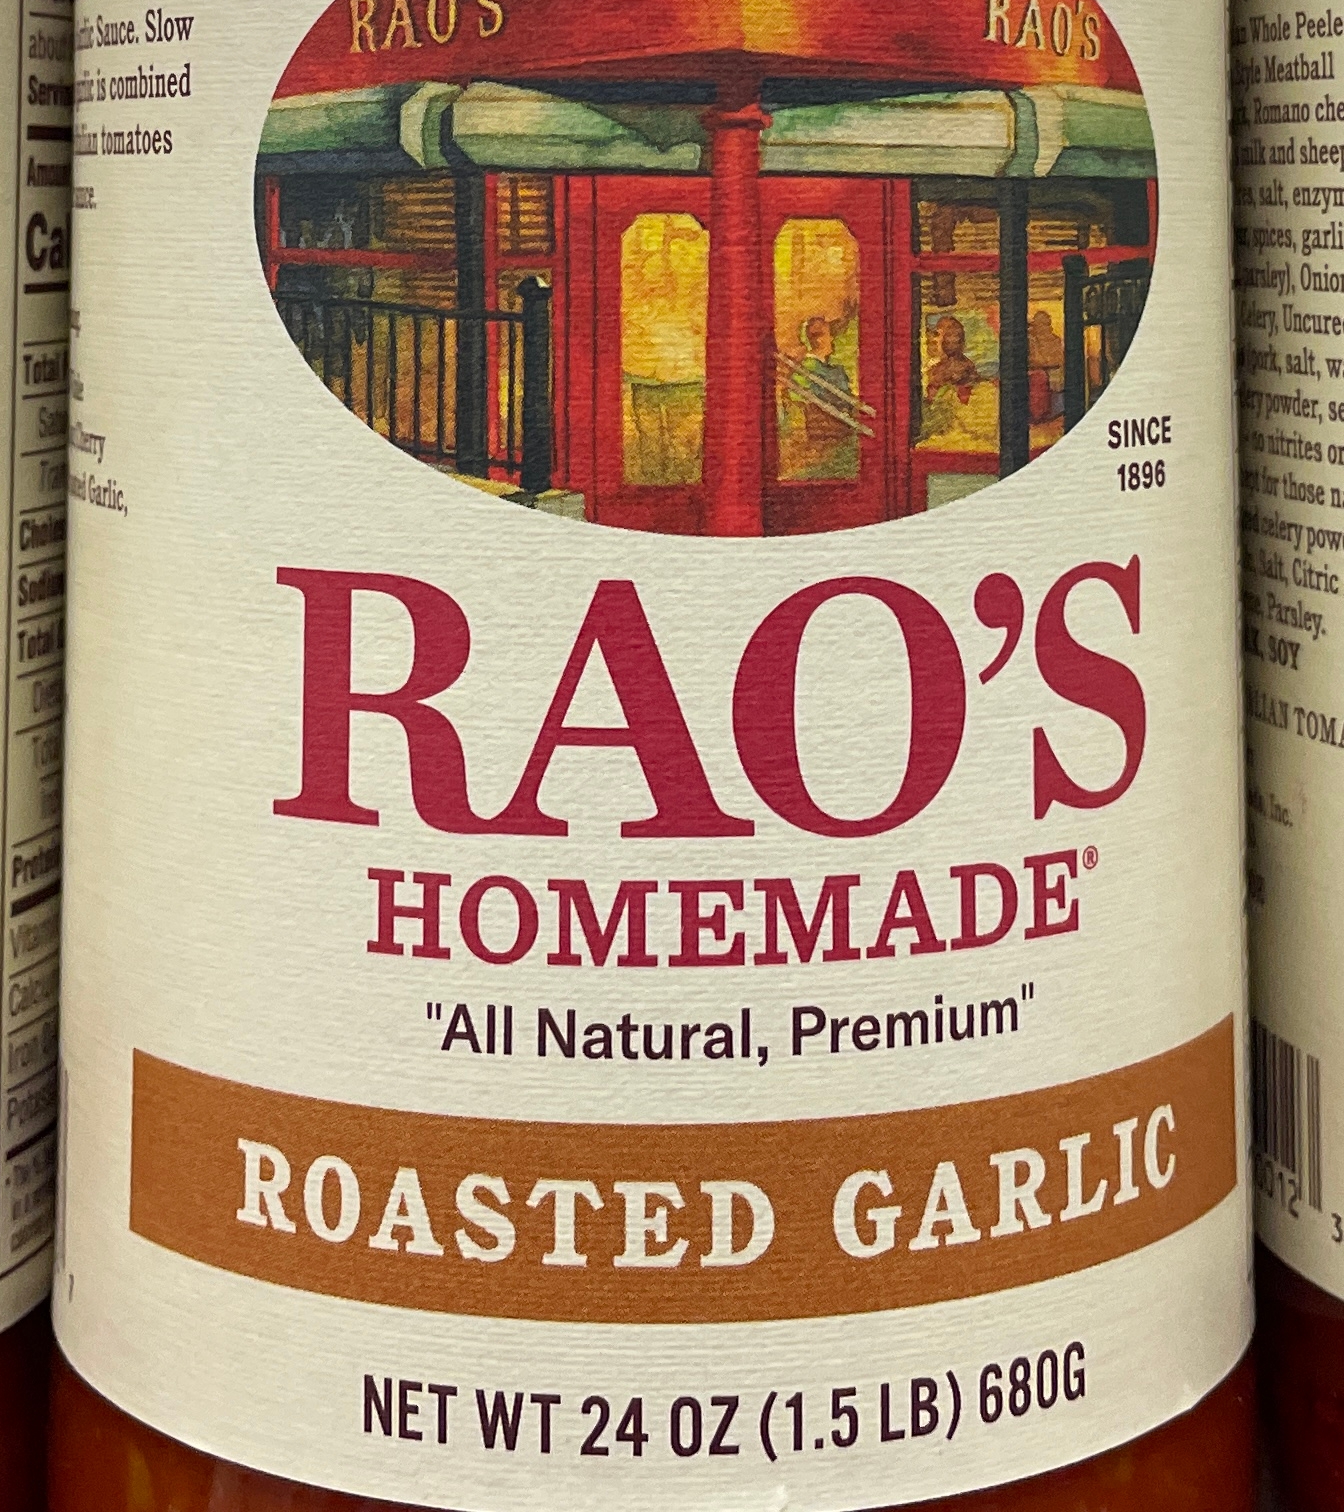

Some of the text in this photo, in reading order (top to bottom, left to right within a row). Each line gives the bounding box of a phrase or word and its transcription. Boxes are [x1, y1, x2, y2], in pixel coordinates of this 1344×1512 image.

[96, 13, 139, 47] Sauce.
[145, 7, 194, 43] Slow
[1249, 14, 1291, 43] Whole
[109, 62, 191, 100] combined
[1264, 51, 1335, 84] Meatball
[1253, 97, 1310, 125] Romano
[101, 123, 173, 155] tomatoes
[1269, 136, 1295, 165] and
[1259, 179, 1288, 210] salt,
[1254, 226, 1297, 254] spices,
[1285, 346, 1321, 382] salt,
[1265, 389, 1323, 425] powder,
[1107, 415, 1173, 451] SINCE
[1268, 428, 1322, 463] nitrites
[1117, 459, 1166, 494] 1896
[1282, 471, 1325, 505] those
[1292, 557, 1339, 595] Citric
[1267, 590, 1326, 641] Parsley.
[1269, 635, 1301, 671] SOY
[272, 553, 1147, 840] RAO'S
[426, 983, 1036, 1068] "All Natural, Premium"
[235, 1137, 776, 1271] ROASTED
[832, 1103, 1179, 1261] GARLIC
[363, 1340, 1087, 1462] NET WT 24 OZ (1.5 LB) 680G
